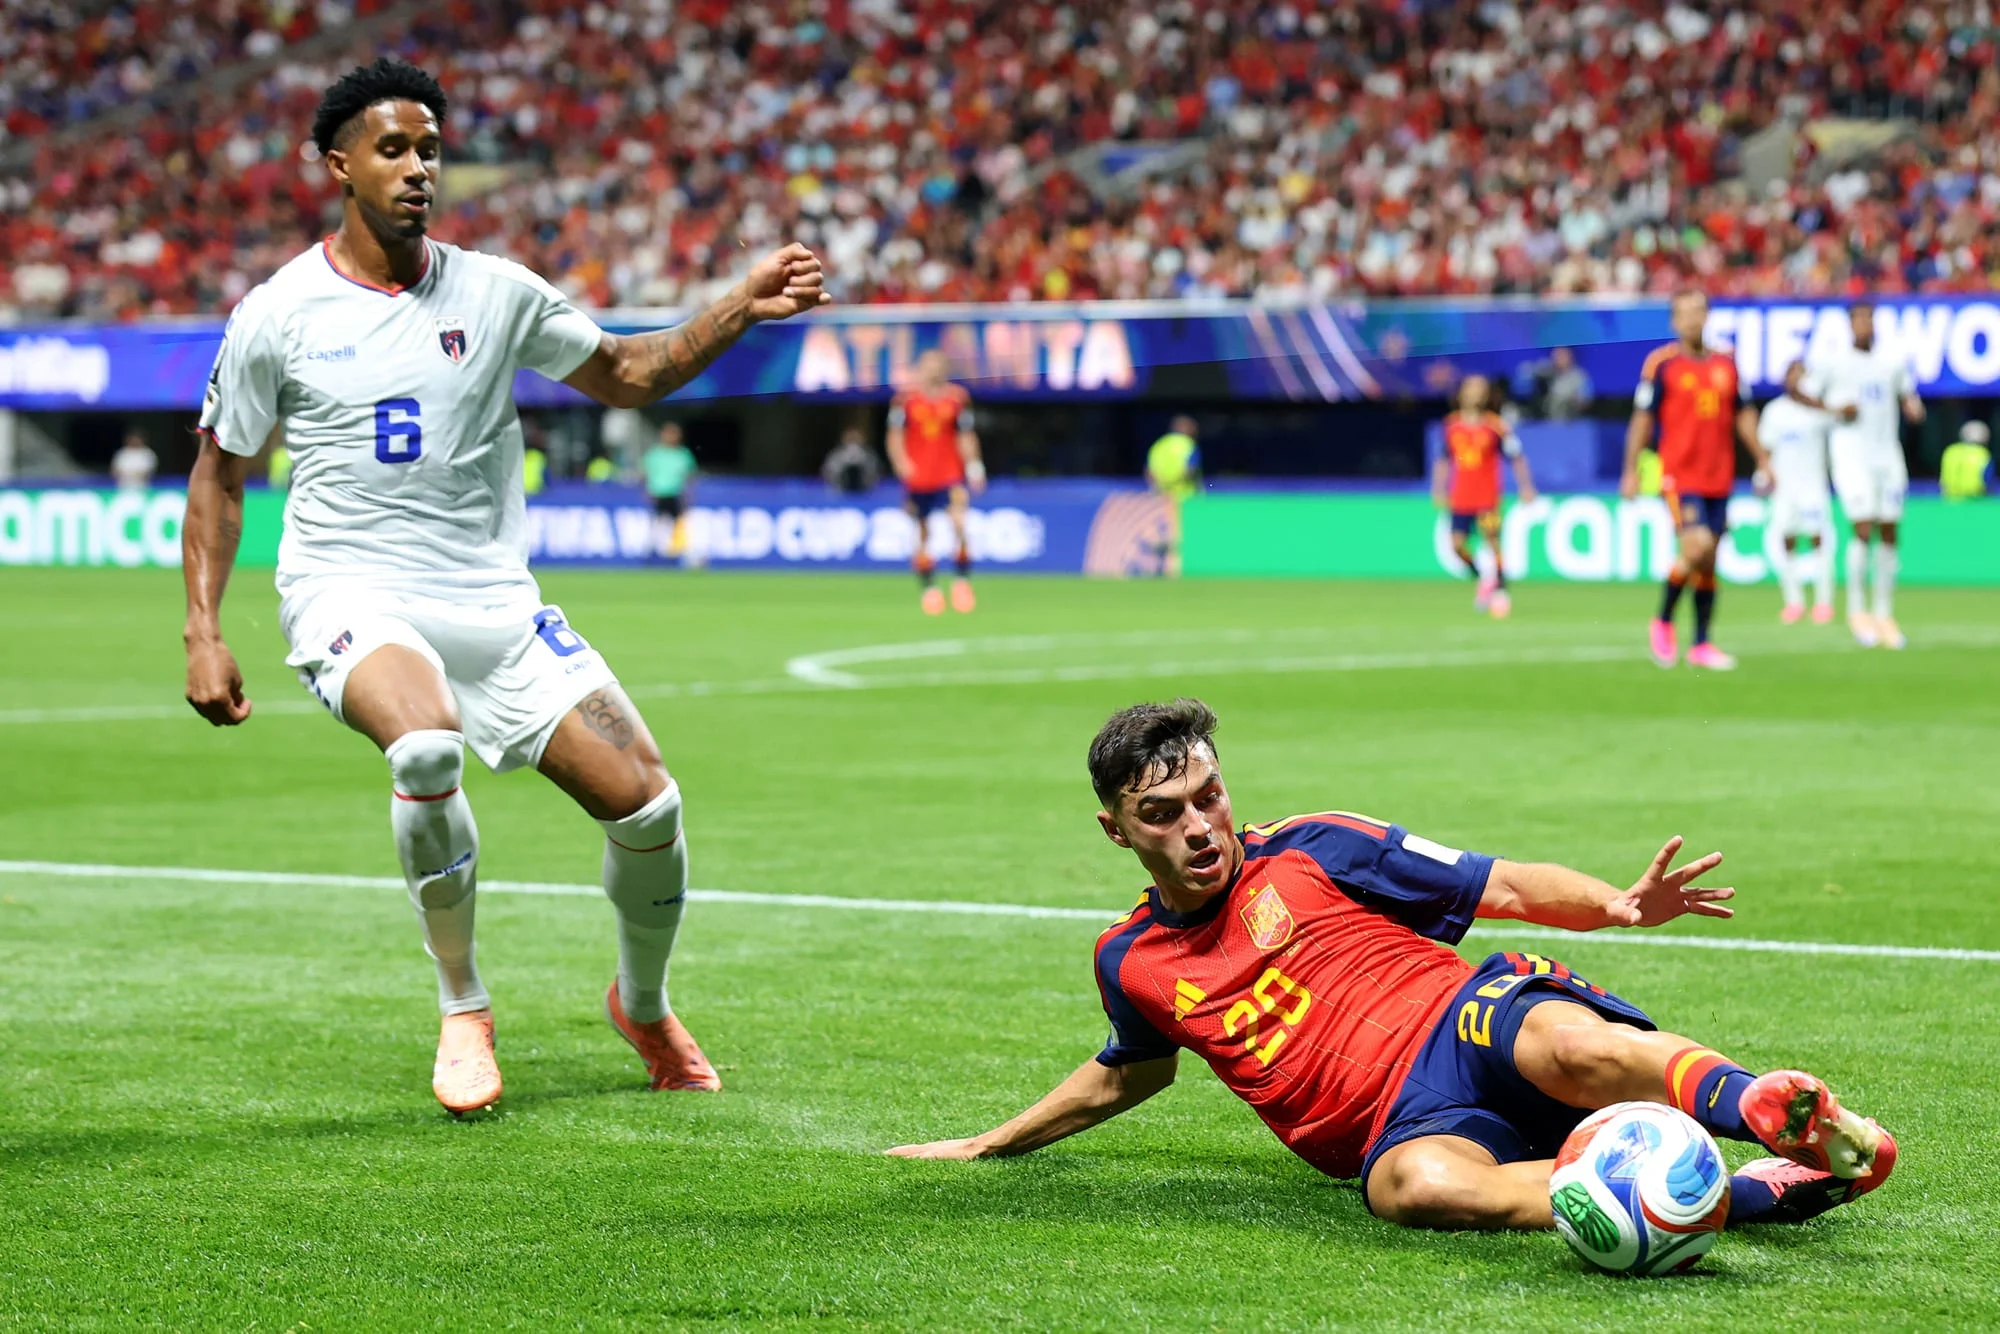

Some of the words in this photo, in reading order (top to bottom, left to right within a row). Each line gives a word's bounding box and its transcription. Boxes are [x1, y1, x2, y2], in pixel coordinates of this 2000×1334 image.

[306, 345, 356, 362] capelli
[795, 321, 1136, 391] ATLANTA
[374, 397, 422, 464] 6
[533, 609, 586, 657] 6
[1223, 967, 1312, 1066] 20
[1457, 974, 1529, 1048] 20
